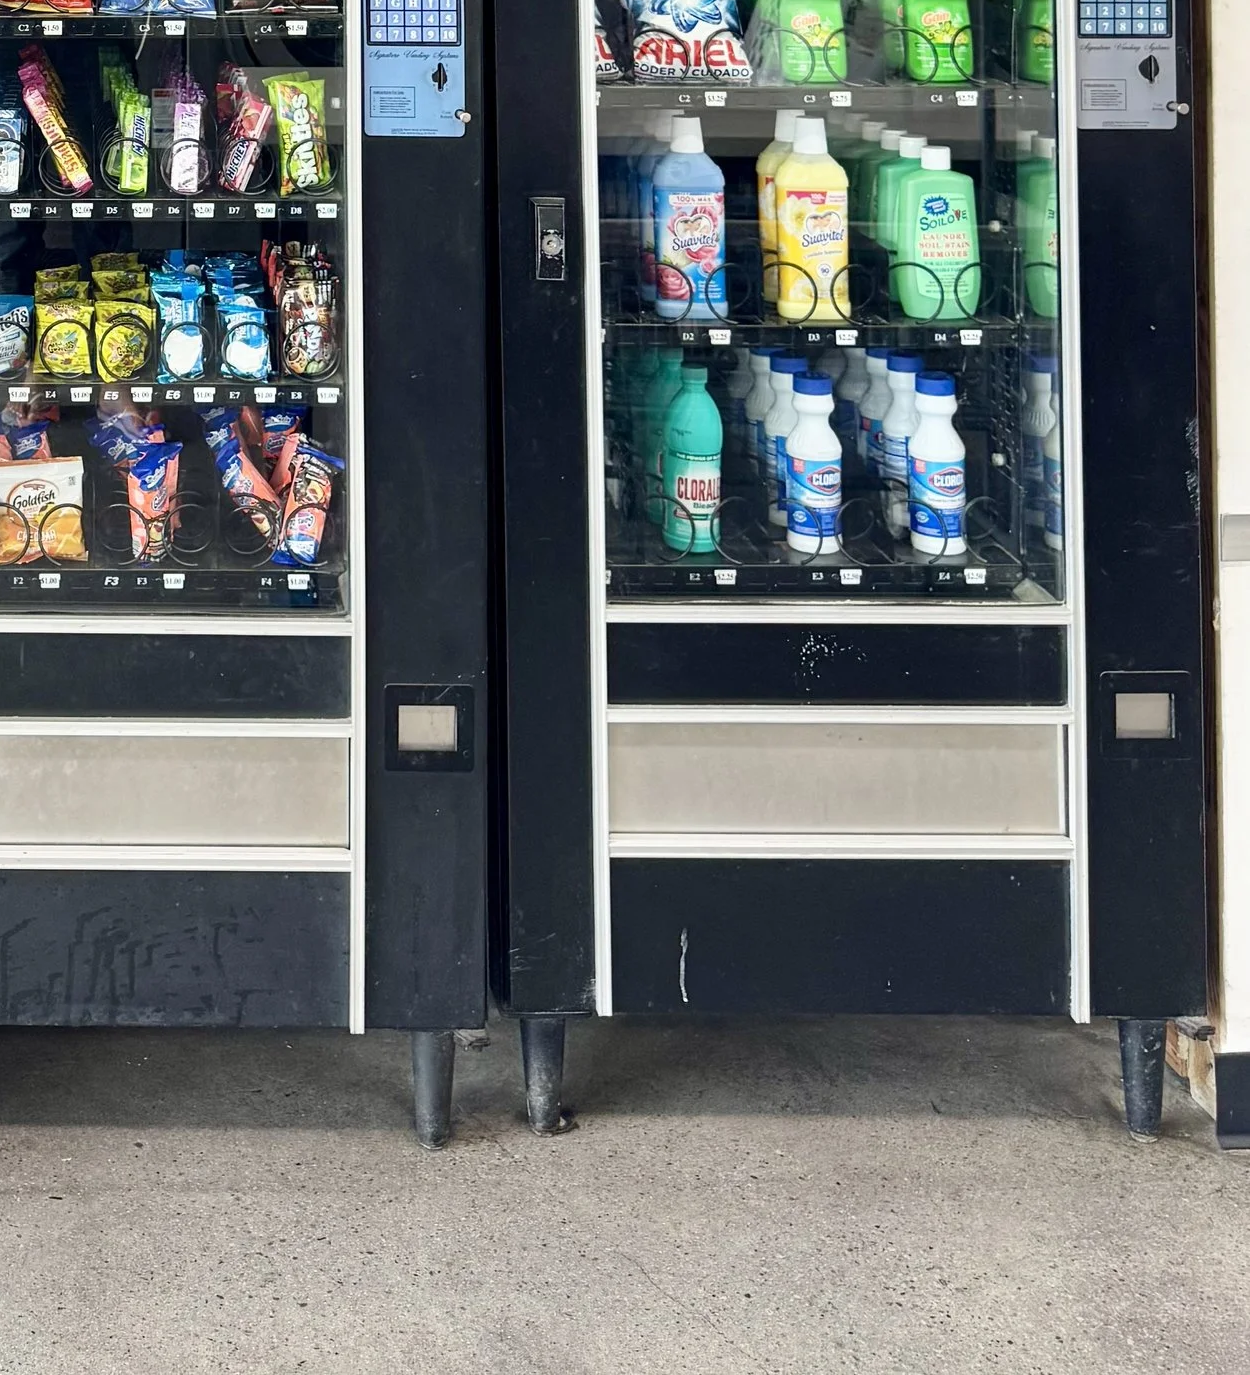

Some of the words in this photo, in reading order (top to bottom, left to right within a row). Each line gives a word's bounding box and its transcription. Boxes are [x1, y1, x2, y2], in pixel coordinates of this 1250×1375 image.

[375, 0, 382, 8] F
[391, 0, 400, 8] G
[409, 0, 418, 8] H
[1086, 7, 1091, 15] 1
[1102, 7, 1109, 15] 2
[1119, 7, 1126, 15] 3
[1137, 7, 1144, 15] 4
[1155, 7, 1161, 15] 5
[376, 14, 381, 23] 1
[393, 14, 399, 23] 2
[410, 14, 416, 23] 3
[427, 14, 434, 23] 4
[445, 14, 451, 23] 5
[19, 24, 29, 32] C2
[139, 24, 150, 32] C3
[260, 24, 272, 32] C4
[1085, 22, 1092, 32] 6
[1102, 22, 1109, 32] 7
[1119, 22, 1126, 32] 8
[1137, 22, 1144, 32] 9
[1153, 22, 1164, 32] 10
[375, 30, 382, 39] 6
[393, 30, 399, 39] 7
[410, 30, 416, 39] 8
[428, 30, 434, 39] 9
[443, 30, 455, 39] 10
[369, 50, 400, 60] Signature
[403, 50, 430, 61] Vending
[433, 50, 459, 61] Systems
[635, 37, 748, 67] ARIEL
[634, 63, 675, 76] PODER
[931, 94, 943, 102] C4
[133, 115, 146, 157] HI-CHEW
[225, 135, 250, 180] HI-CHEW
[12, 206, 29, 214] $2.00
[45, 206, 57, 214] D4
[74, 206, 90, 214] $2.00
[107, 206, 118, 214] D5
[134, 206, 151, 214] $2.00
[168, 206, 180, 214] D6
[195, 206, 212, 214] $2.00
[229, 206, 240, 214] D7
[256, 206, 273, 214] $2.00
[290, 206, 302, 214] D8
[318, 206, 335, 214] $2.00
[672, 233, 718, 252] Suavitel
[802, 229, 845, 248] Suavitel
[935, 333, 946, 341] D4
[13, 489, 56, 512] Goldfish
[105, 577, 119, 585] F3
[716, 573, 734, 581] $2.25
